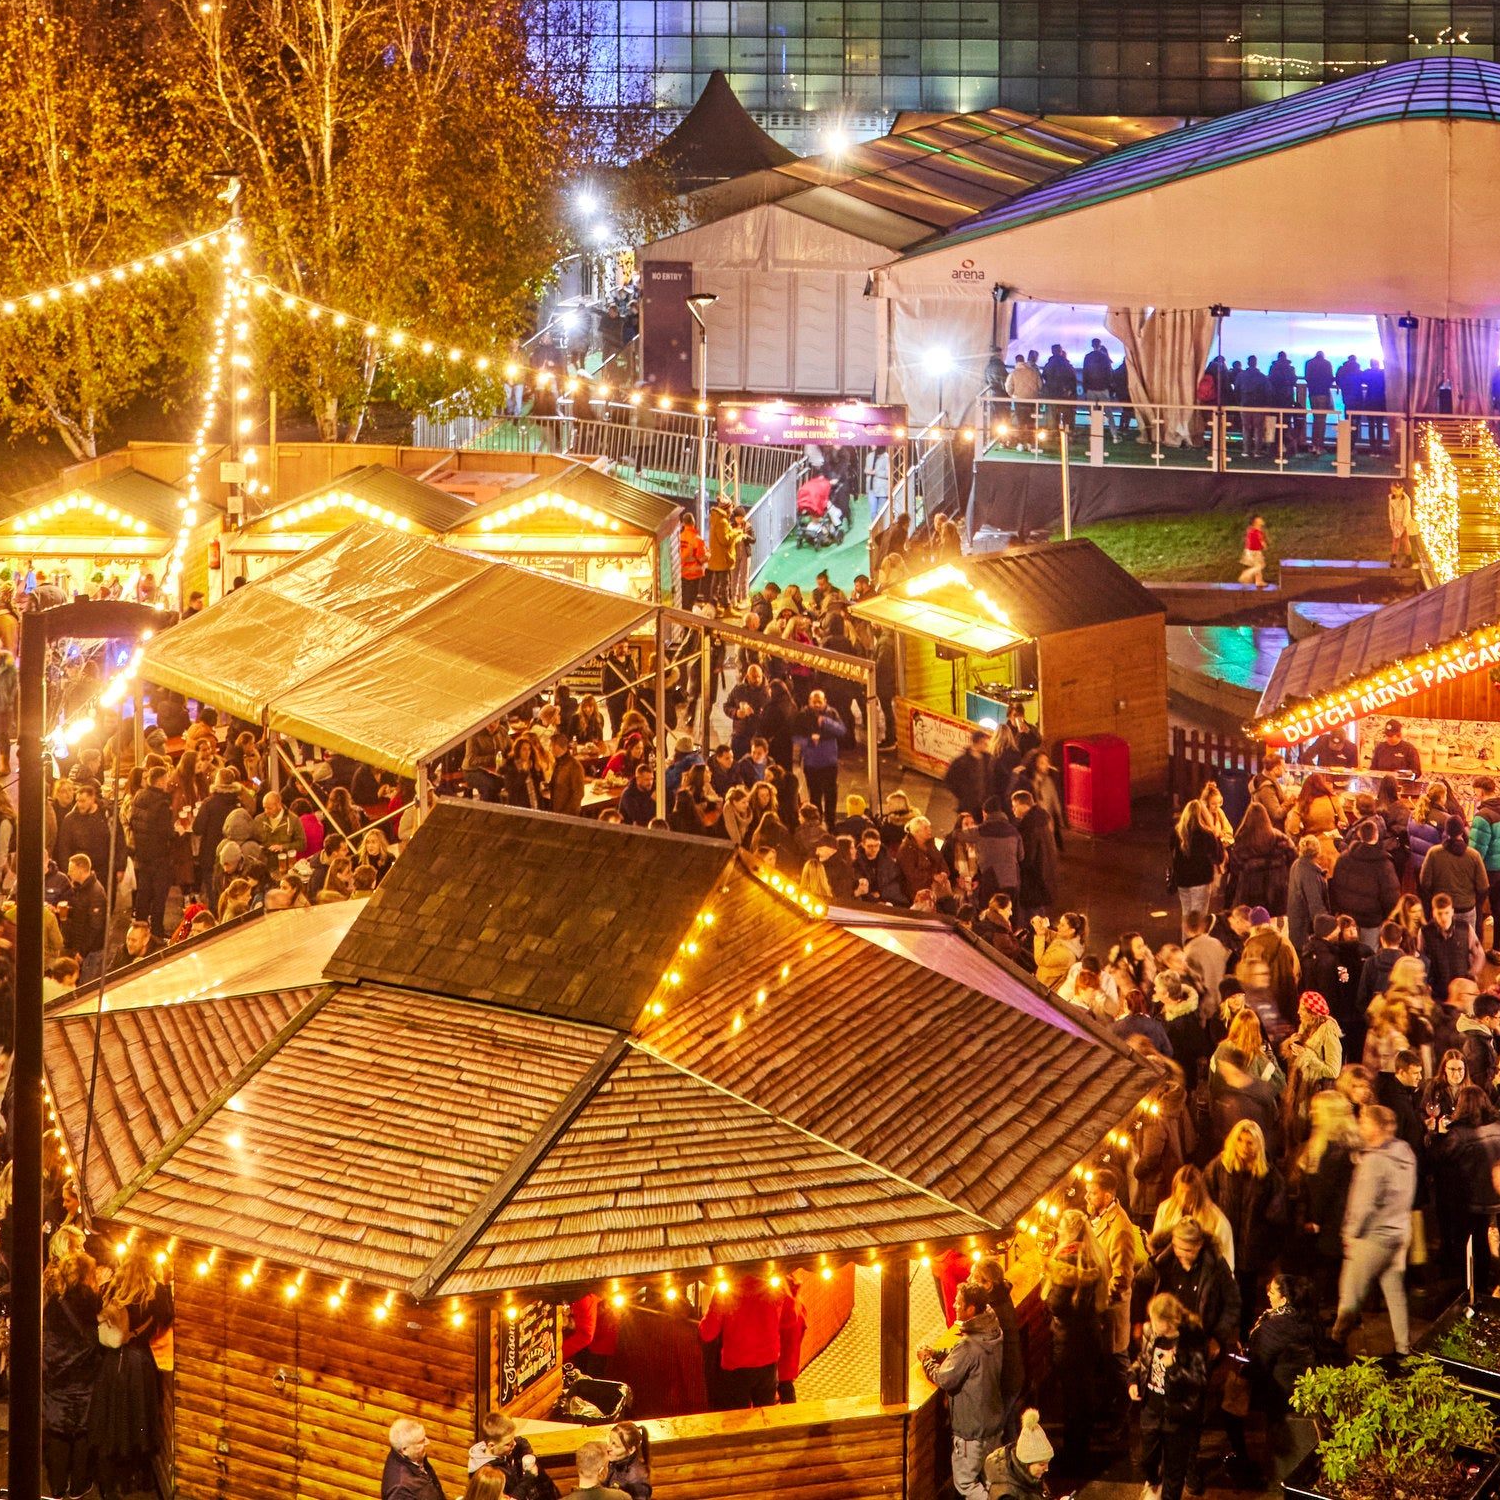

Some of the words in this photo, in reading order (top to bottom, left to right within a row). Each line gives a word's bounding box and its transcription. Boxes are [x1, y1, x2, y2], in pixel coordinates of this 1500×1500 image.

[652, 272, 661, 281] NO
[662, 272, 683, 281] ENTRY
[951, 269, 985, 280] arena
[1282, 701, 1356, 743] DUTCH
[1359, 676, 1420, 714] MINI
